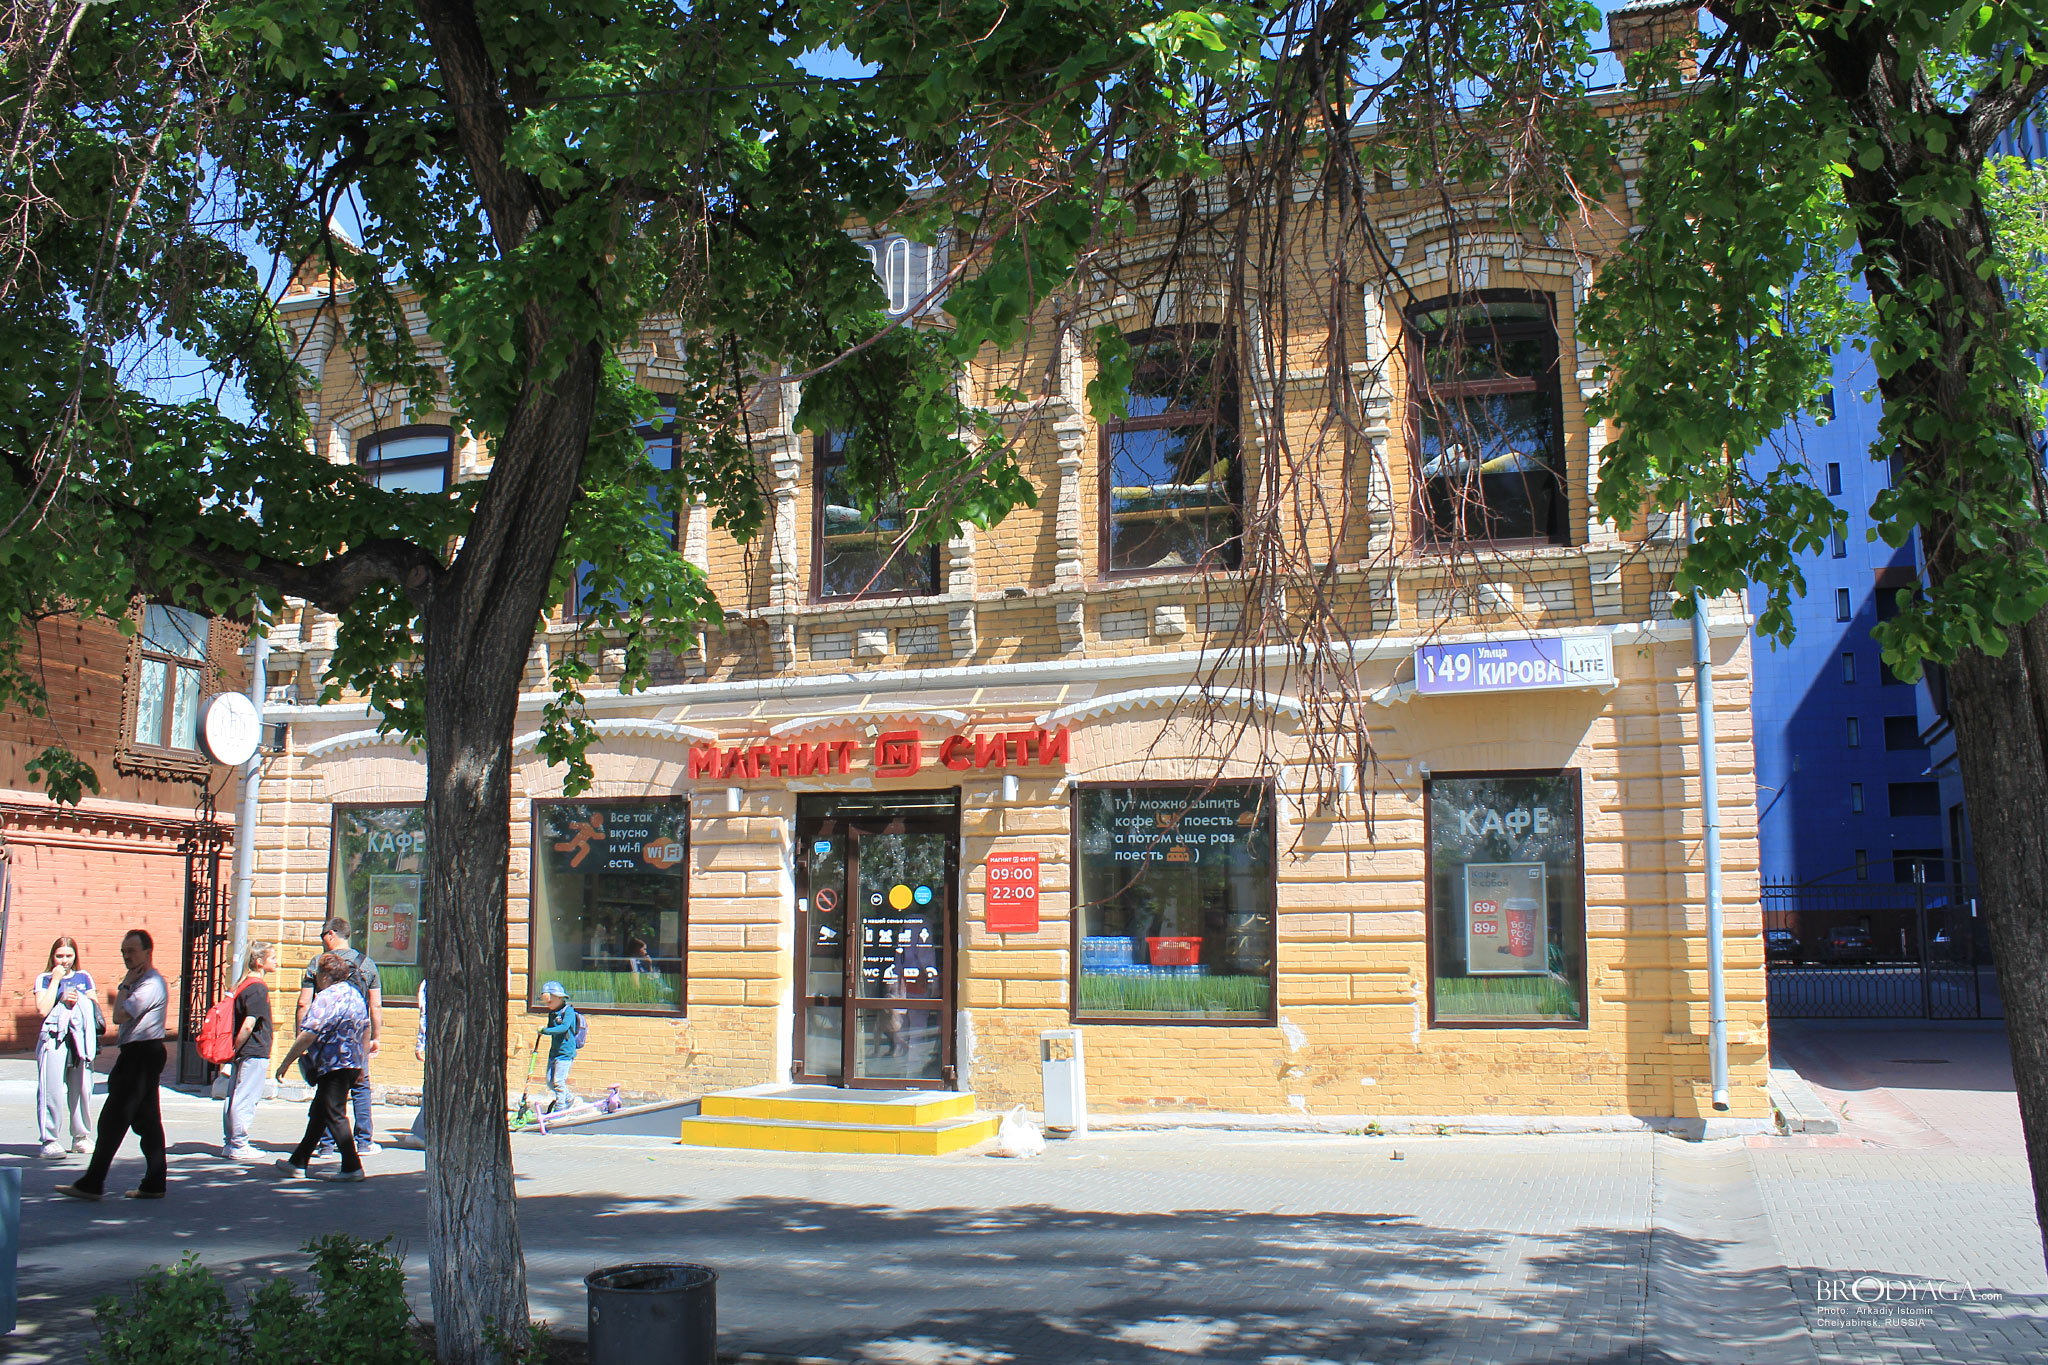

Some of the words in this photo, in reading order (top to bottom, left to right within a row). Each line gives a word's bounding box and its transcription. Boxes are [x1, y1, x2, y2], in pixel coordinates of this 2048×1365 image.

[1478, 647, 1508, 659] Улица
[1423, 653, 1471, 683] 149
[1569, 658, 1604, 673] LITE
[1478, 659, 1562, 685] КИРОВА
[688, 741, 858, 779] МАГНИТ
[940, 728, 1070, 771] СИТИ
[1140, 800, 1187, 810] можно
[610, 812, 631, 823] Все
[633, 814, 653, 823] так
[1115, 815, 1154, 830] кофе
[1184, 816, 1233, 826] поесть
[1459, 807, 1549, 836] КАФЕ
[610, 829, 649, 840] вкусно
[1115, 834, 1123, 843] а
[1128, 834, 1172, 843] потом
[1175, 834, 1206, 844] еще
[1210, 834, 1235, 845] раз
[368, 830, 426, 853] КАФЕ
[609, 844, 616, 852] и
[618, 842, 641, 853] wi-fi
[1114, 851, 1164, 860] поесть
[609, 860, 634, 868] есть
[991, 868, 1033, 880] 09:00
[992, 886, 1035, 899] 22:00
[863, 968, 880, 978] WC
